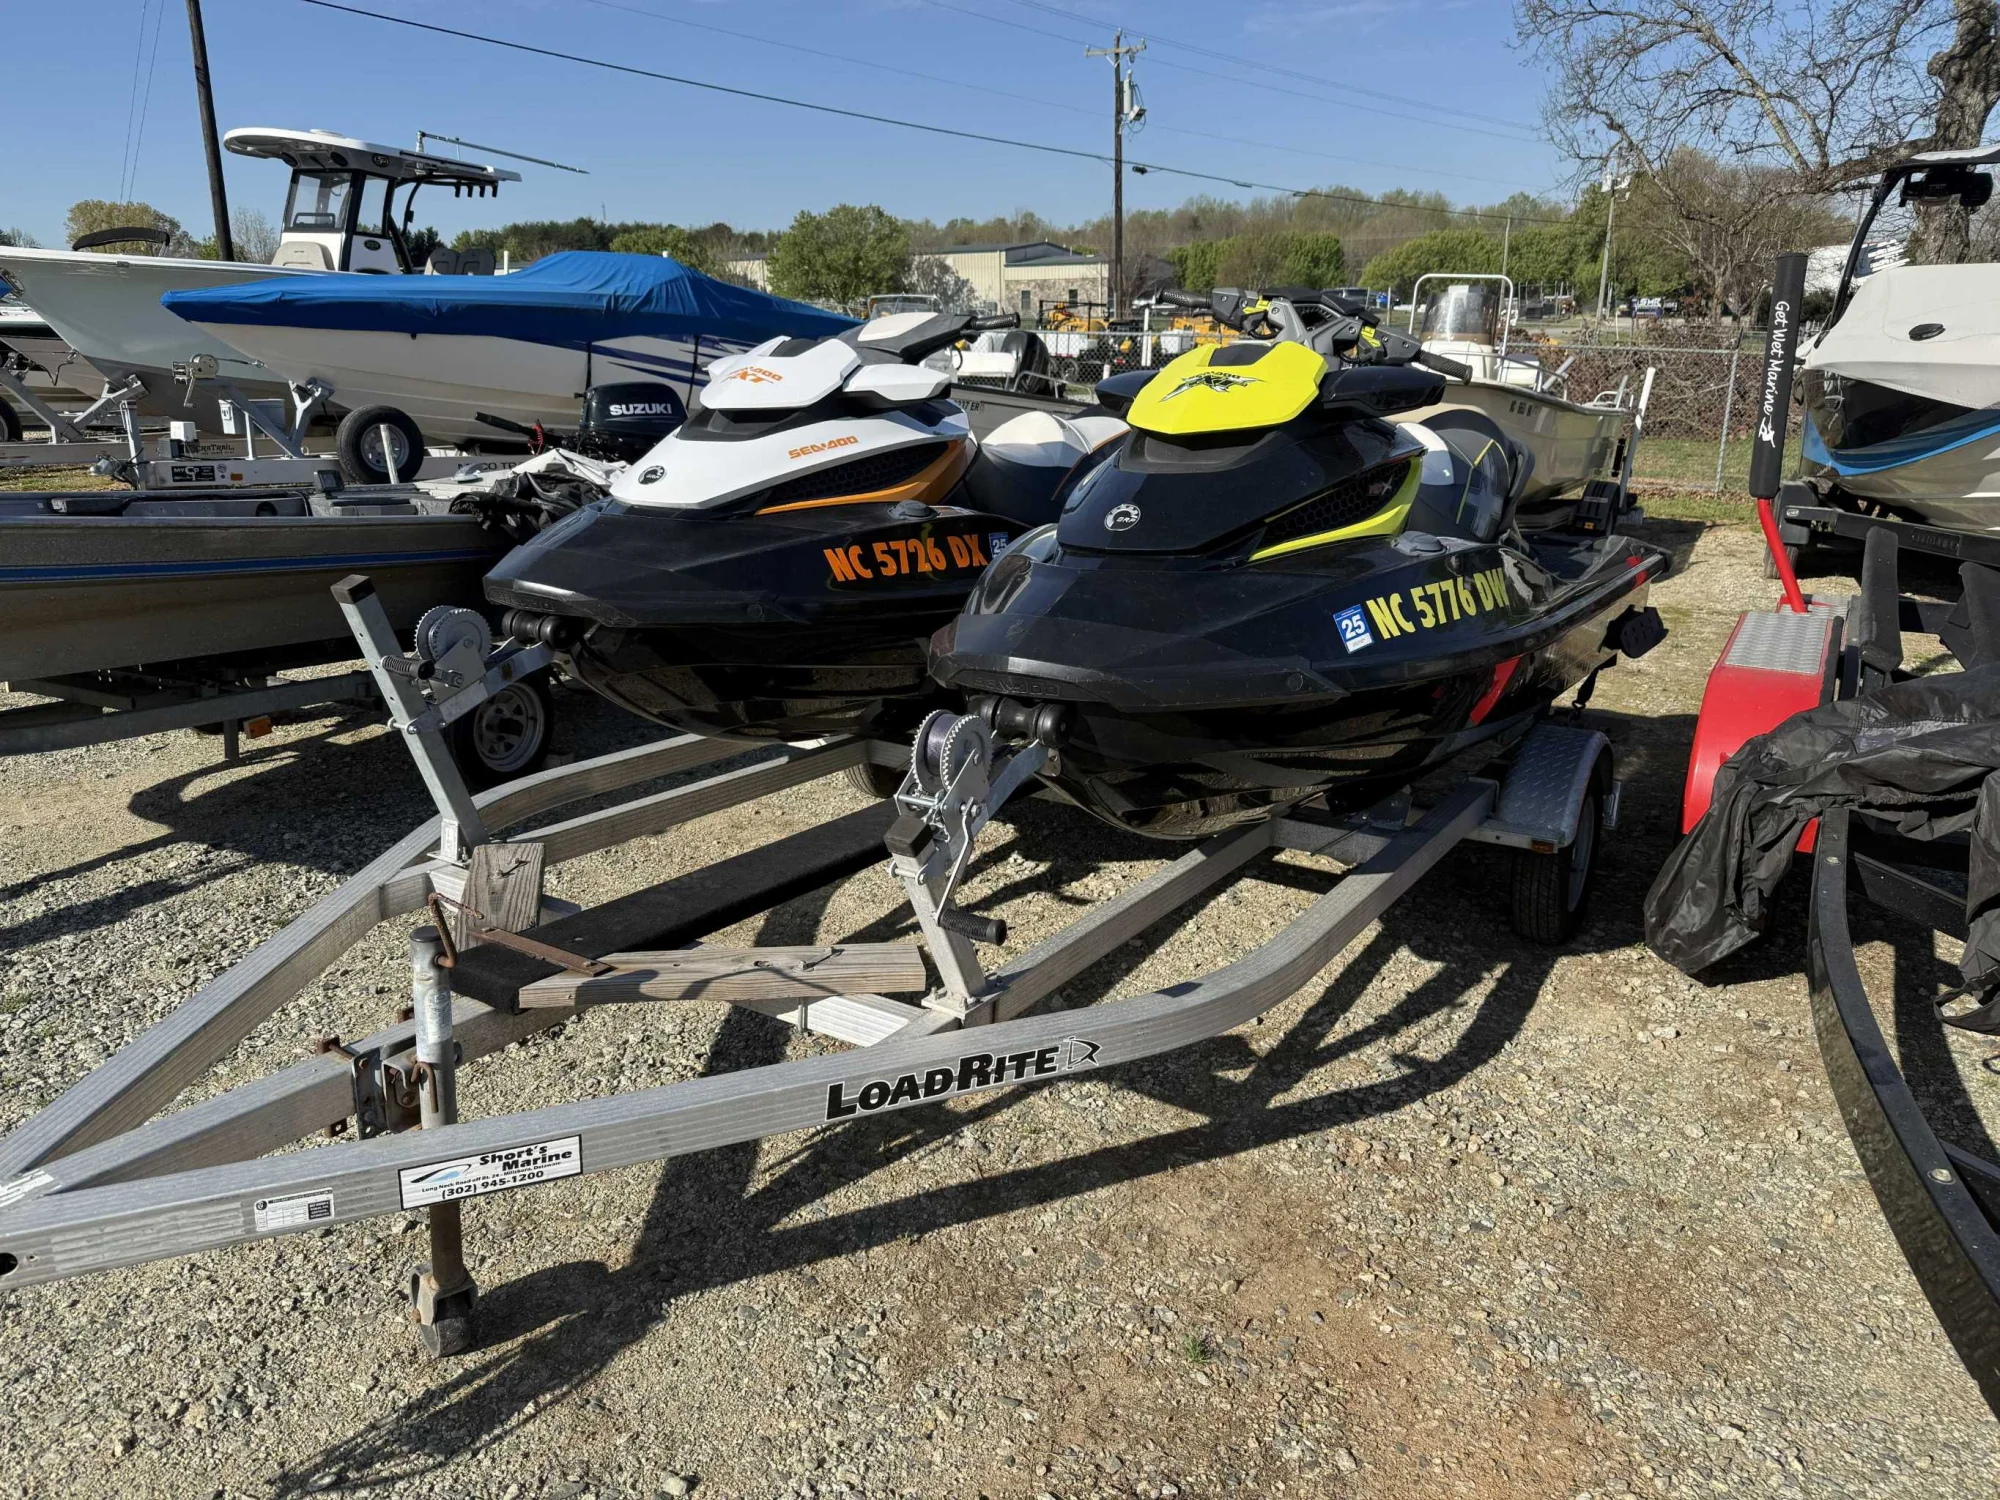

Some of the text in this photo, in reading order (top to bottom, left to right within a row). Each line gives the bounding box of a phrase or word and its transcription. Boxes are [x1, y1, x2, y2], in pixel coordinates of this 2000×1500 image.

[1763, 301, 1790, 416] Get Wet Marine
[609, 403, 672, 416] SUZUKI
[823, 534, 989, 582] NC 5726 DX
[992, 538, 1007, 554] 25
[1366, 567, 1510, 640] NC 5776 DW
[1341, 614, 1366, 640] 25
[479, 1145, 548, 1166] Short's
[502, 1150, 573, 1172] Marine
[441, 1170, 544, 1200] (302) 945-1200
